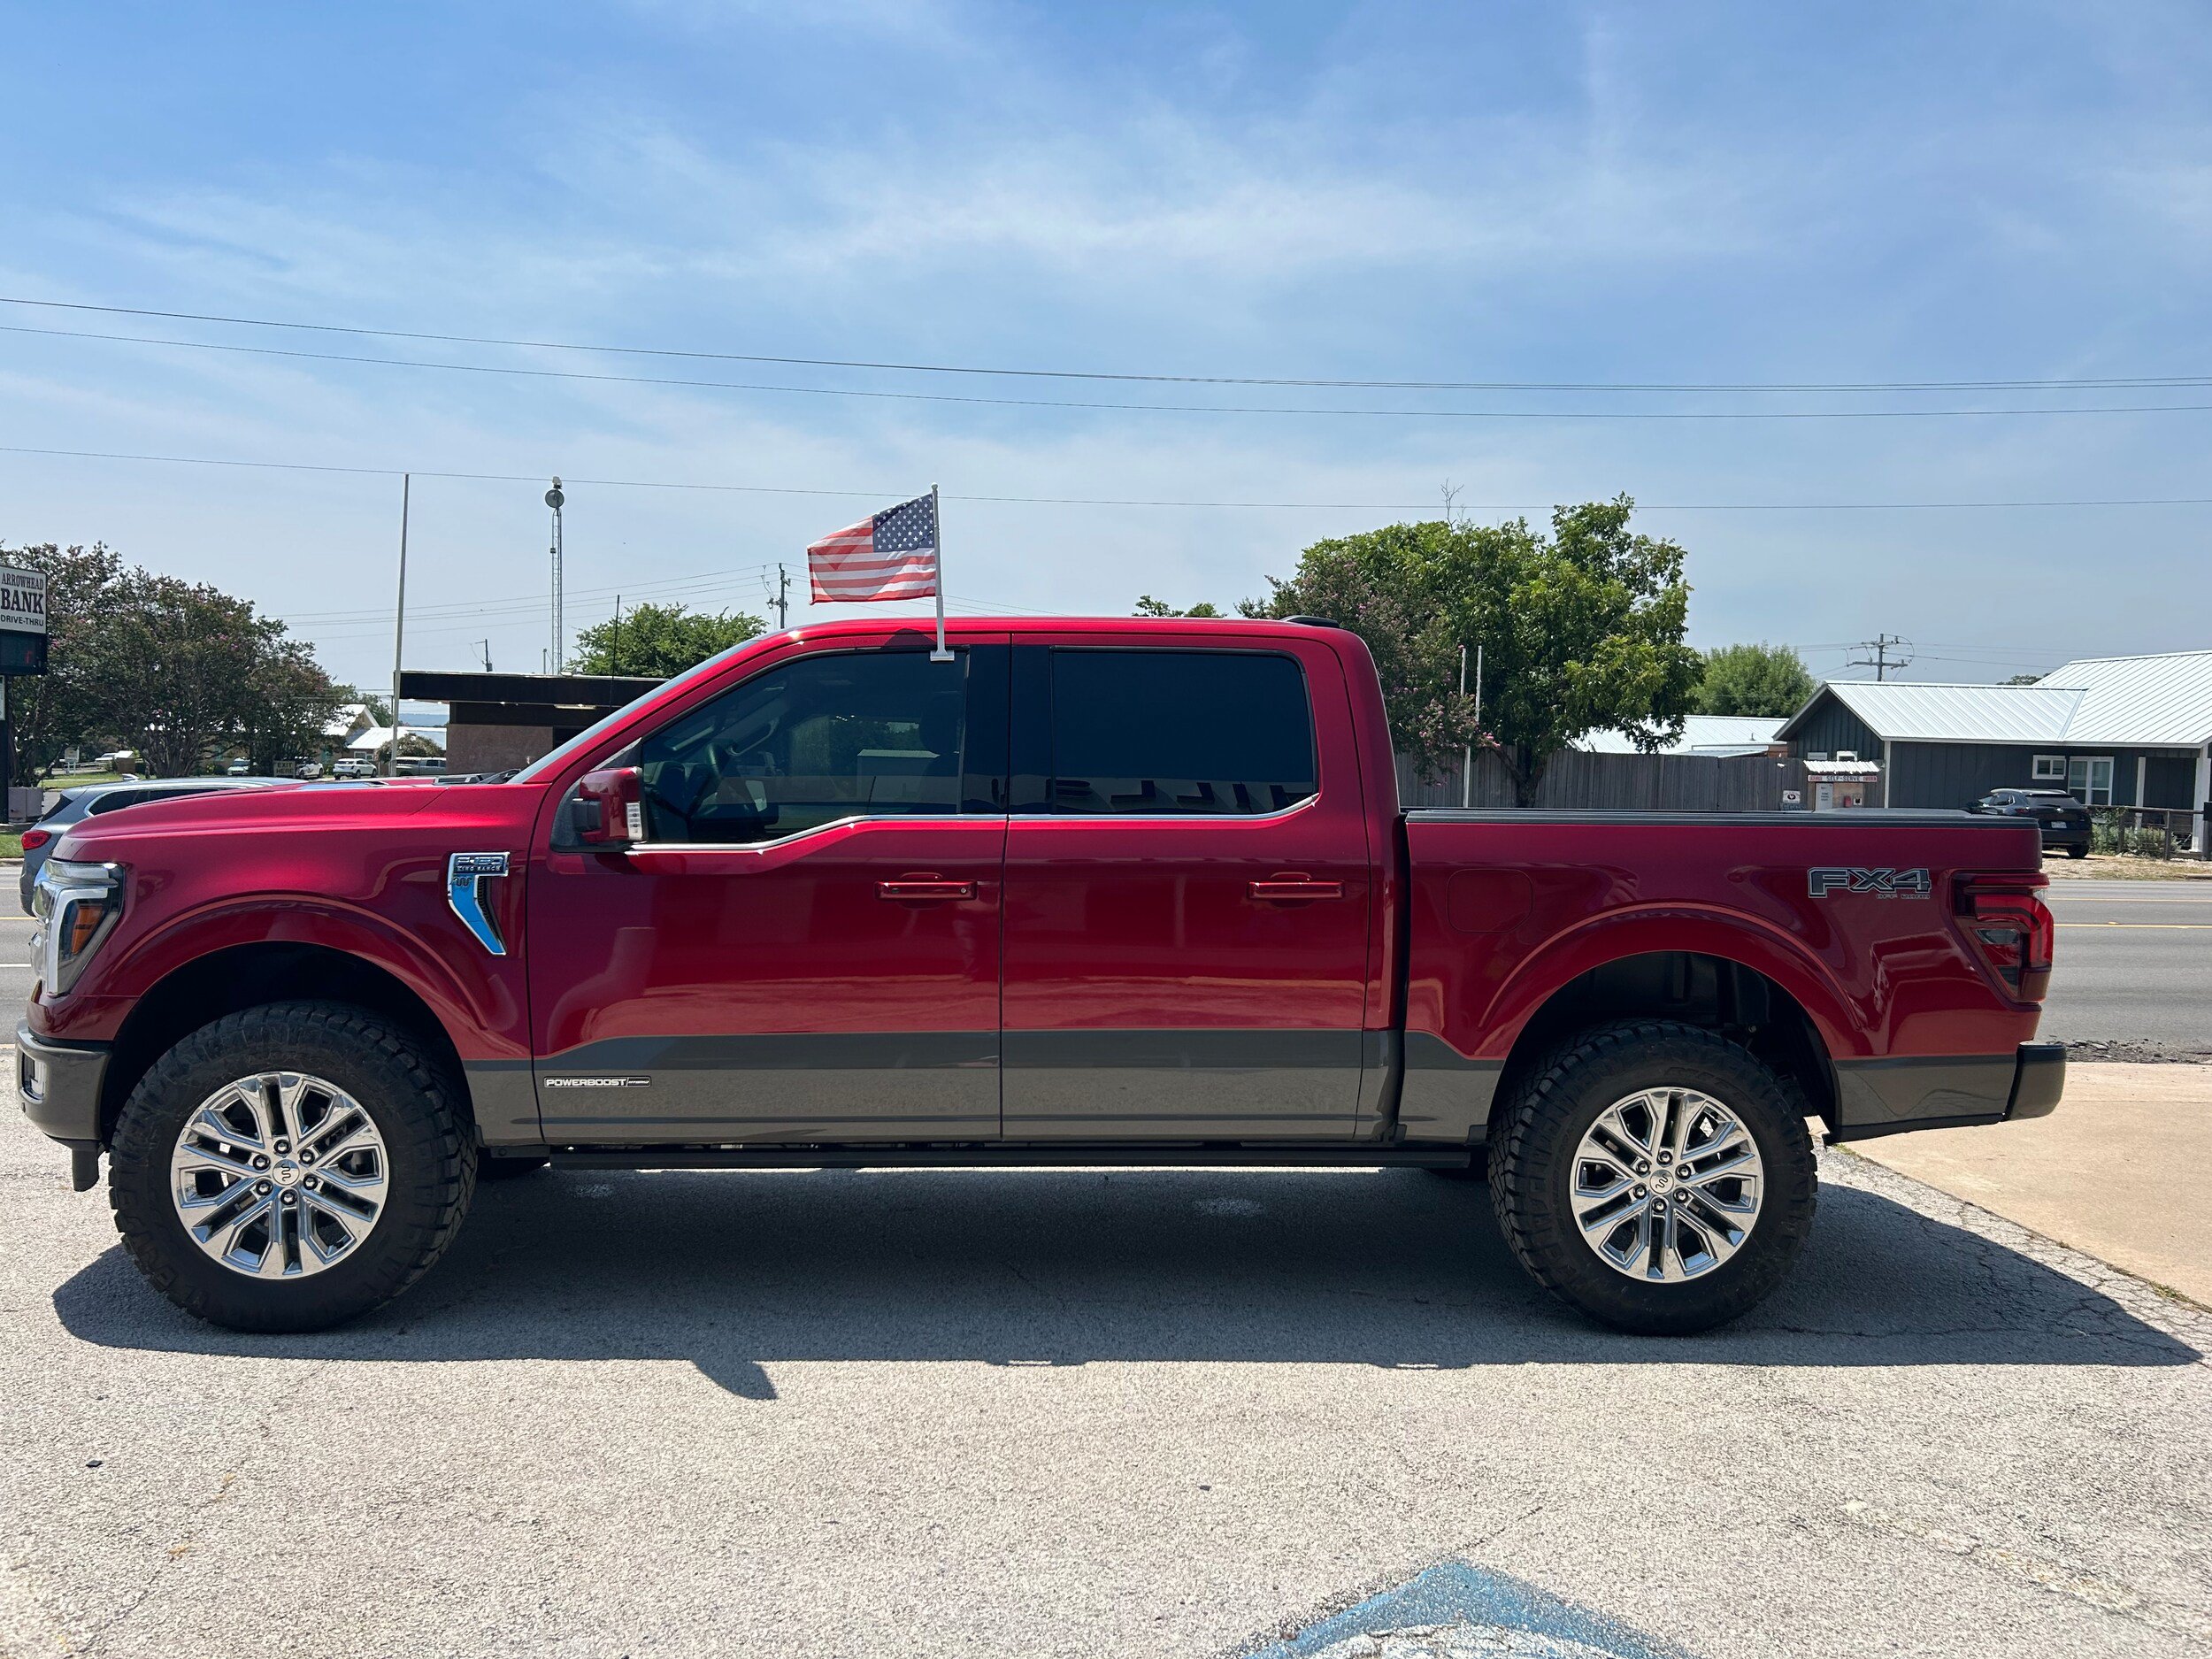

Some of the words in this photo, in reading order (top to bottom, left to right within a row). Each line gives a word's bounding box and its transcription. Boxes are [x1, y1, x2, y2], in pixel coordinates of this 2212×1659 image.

[1, 572, 43, 590] ARROWHEAD
[0, 588, 44, 614] BANK
[0, 614, 44, 626] DRIVE-THRU
[1807, 866, 1932, 899] FX4
[545, 1078, 627, 1087] POWERBOOST
